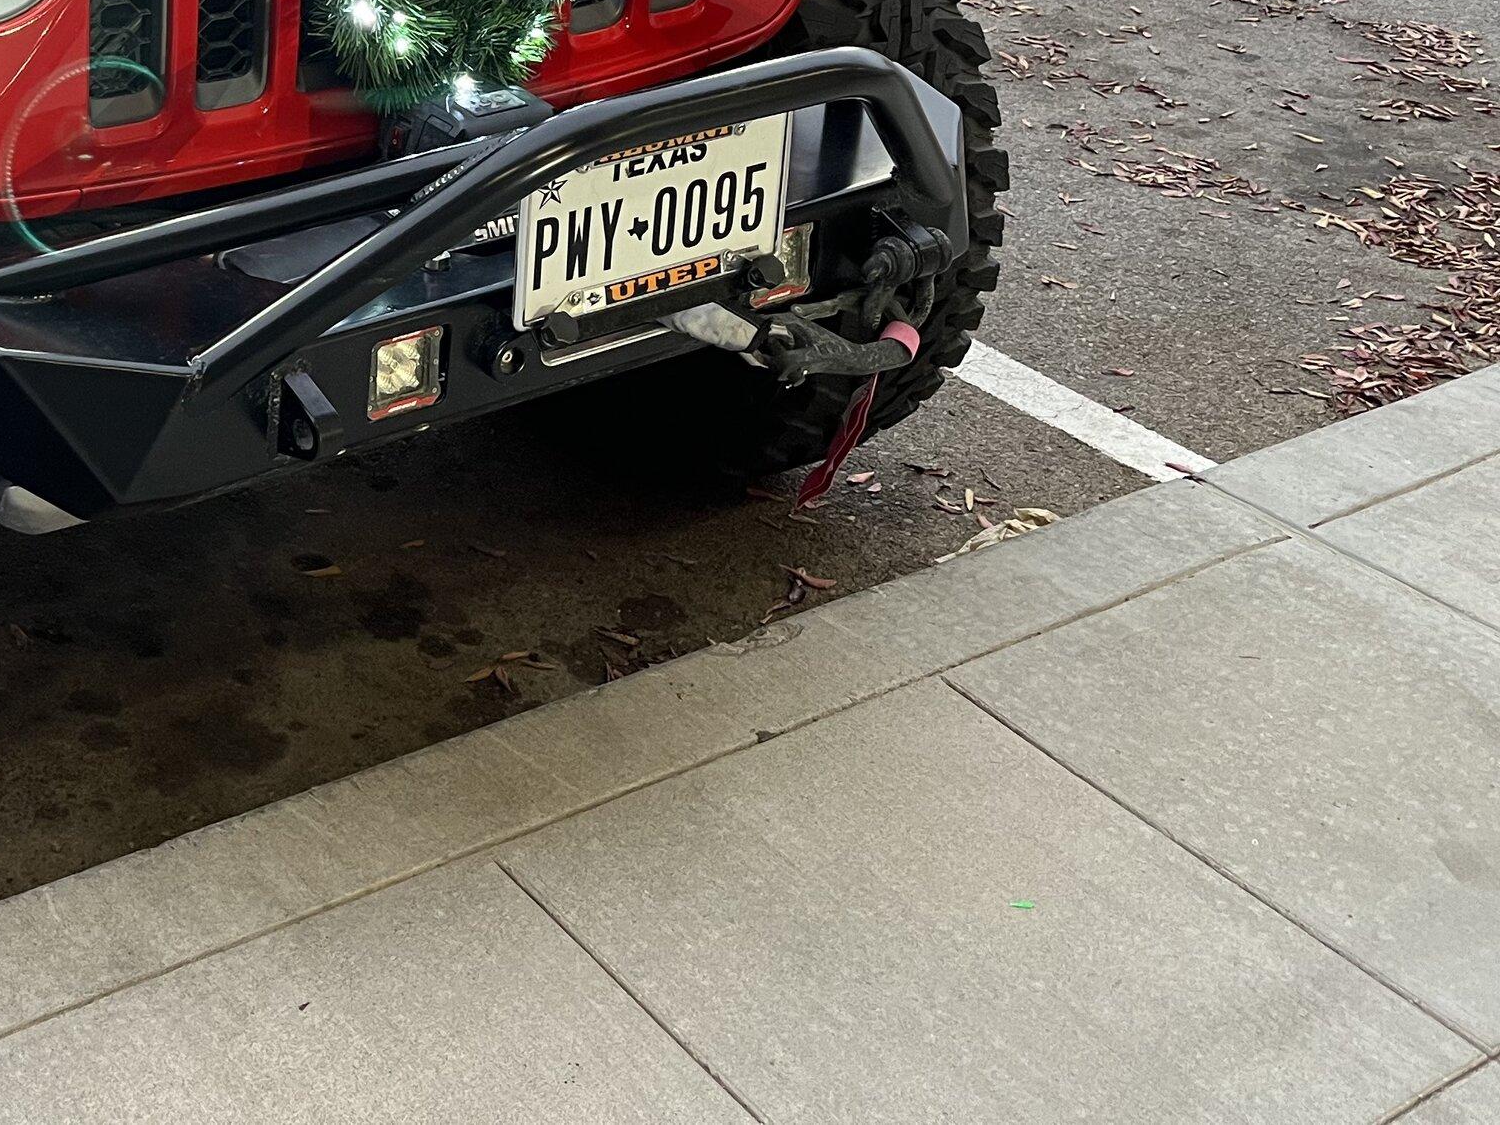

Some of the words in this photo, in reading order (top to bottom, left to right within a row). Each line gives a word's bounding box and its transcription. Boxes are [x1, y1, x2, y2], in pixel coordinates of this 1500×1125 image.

[473, 214, 520, 242] SMI
[532, 198, 624, 291] PWY
[650, 161, 768, 257] 0095
[609, 256, 720, 302] UTEP
